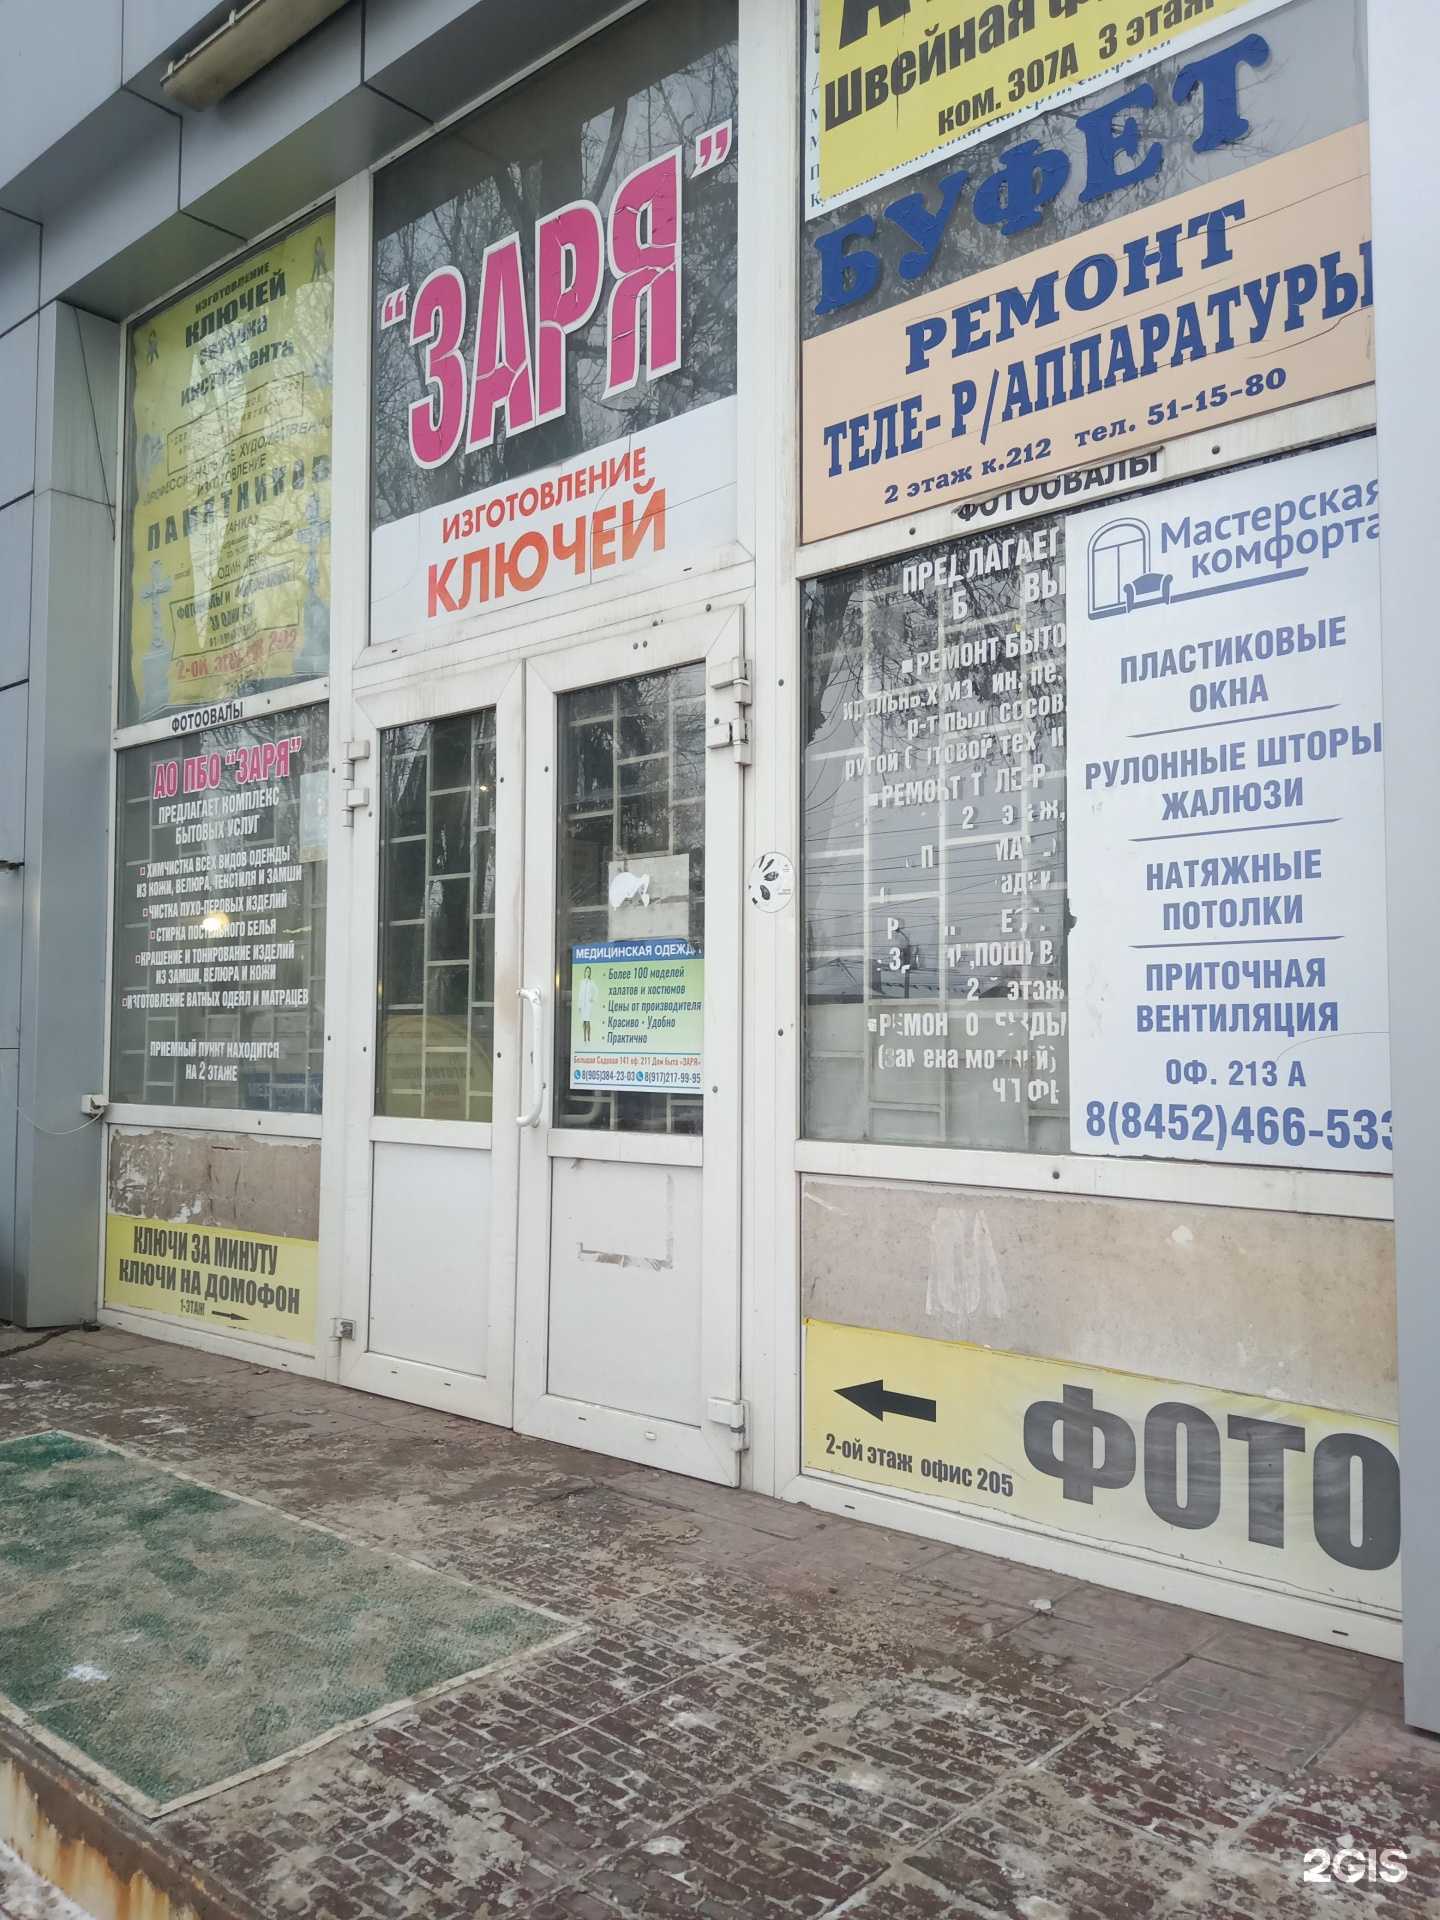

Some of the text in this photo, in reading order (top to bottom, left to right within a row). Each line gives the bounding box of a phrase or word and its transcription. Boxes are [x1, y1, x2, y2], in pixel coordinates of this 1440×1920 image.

[825, 0, 1035, 131] Швейная
[938, 87, 1001, 136] ком.
[1008, 42, 1078, 102] 307А
[1099, 23, 1117, 60] 3
[815, 33, 1270, 315] БУФЕТ
[195, 262, 270, 314] ИЗГОТОВЛЕНИЕ
[905, 200, 1246, 375] РЕМОНТ
[185, 268, 287, 348] КЛЮЧЕЙ
[884, 368, 1287, 504] 2 этаж к.212 тел. 51-15-80
[442, 447, 646, 544] ИЗГОТОВЛЕНИЕ
[427, 477, 666, 618] КЛЮЧЕЙ
[916, 638, 1000, 676] РЕМОНТ
[1120, 616, 1346, 685] ПЛАСТИКОВЫЕ
[1189, 674, 1268, 713] ОКНА
[172, 702, 243, 733] ФОТООВАЛЫ
[1085, 722, 1382, 790] РУЛОННЫЕ ШТОРЫ
[153, 761, 179, 800] АО
[1161, 777, 1303, 821] ЖАЛЮЗИ
[158, 786, 280, 824] ПРЕДЛАГАЕТ КОМПЛЕКС
[175, 814, 260, 845] БЫТОВЫХ УСЛУГ
[146, 845, 290, 878] ХИМЧИСТКА ВСЕХ ВИДОВ ОДЕЖДЫ
[1146, 849, 1321, 891] НАТЯЖНЫЕ
[136, 883, 147, 898] ИЗ
[258, 870, 265, 884] И
[266, 865, 302, 883] ЗАМШИ
[149, 904, 179, 920] ЧИСТКА
[246, 890, 288, 912] ИЗДЕЛИЙ
[1162, 894, 1303, 930] ПОТОЛКИ
[156, 925, 186, 942] СТИРКА
[247, 918, 276, 935] БЕЛЬЯ
[140, 940, 295, 966] КРАШЕНИЕ И ТОНИРОВАНИЕ ИЗДЕЛИЙ
[576, 945, 652, 960] МЕДИЦИНСКАЯ
[156, 963, 276, 984] ИЗ ЗАМШИ, ВЕЛЮРА И КОЖИ
[608, 966, 685, 980] Более 100 моделей
[608, 986, 638, 996] халатов
[640, 986, 646, 995] и
[1146, 957, 1326, 991] ПРИТОЧНАЯ
[127, 988, 309, 1009] ИЗГОТОВЛЕНИЕ ВАТНЫХ ОДЕЯЛ И МАТРАЦЕВ
[608, 1000, 702, 1014] Цены от производителя
[607, 1015, 676, 1030] Красиво Удобно
[1136, 1001, 1338, 1037] ВЕНТИЛЯЦИЯ
[150, 1039, 280, 1061] ПРИЕМНЫЙ ПУНКТ НАХОДИТСЯ
[607, 1031, 648, 1046] Практично
[185, 1061, 238, 1081] НА 2 ЭТАЖЕ
[1166, 1059, 1306, 1087] ОФ. 213 А
[134, 1226, 278, 1276] КЛЮЧИ ЗА МИНУТУ
[119, 1259, 300, 1315] КЛЮЧИ НА ДОМОФОН
[826, 1433, 1014, 1499] 2-ой этаж офис 205
[1023, 1383, 1400, 1571] ФОТО
